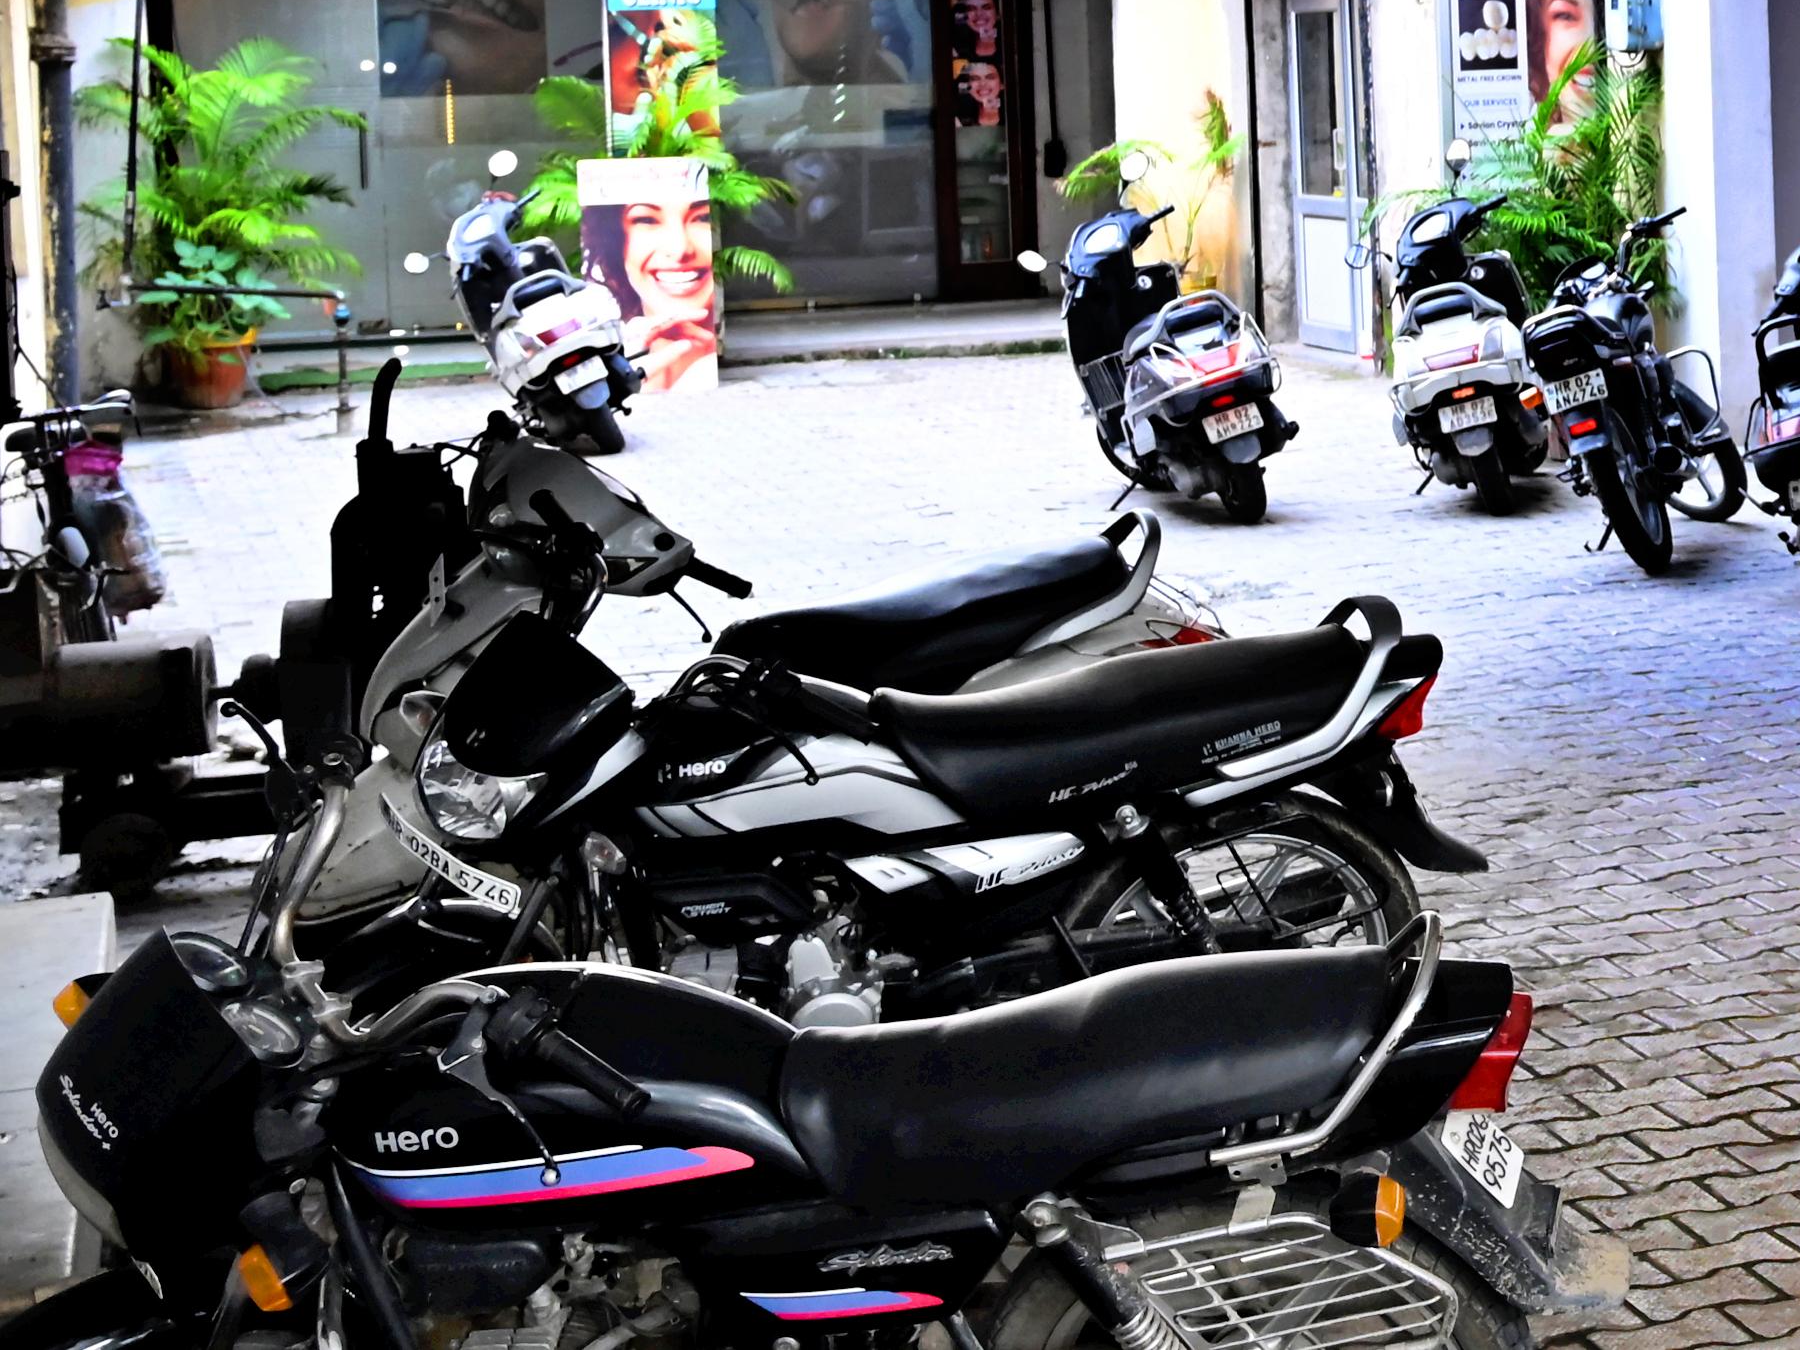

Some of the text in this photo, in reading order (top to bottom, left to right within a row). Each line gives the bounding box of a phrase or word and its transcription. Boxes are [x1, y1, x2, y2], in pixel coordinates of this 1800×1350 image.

[1554, 373, 1592, 395] HR 02
[678, 759, 727, 778] Hero
[455, 869, 512, 906] 5746
[90, 1102, 119, 1139] Hero
[374, 1126, 460, 1154] Hero
[1482, 1128, 1513, 1191] 9575
